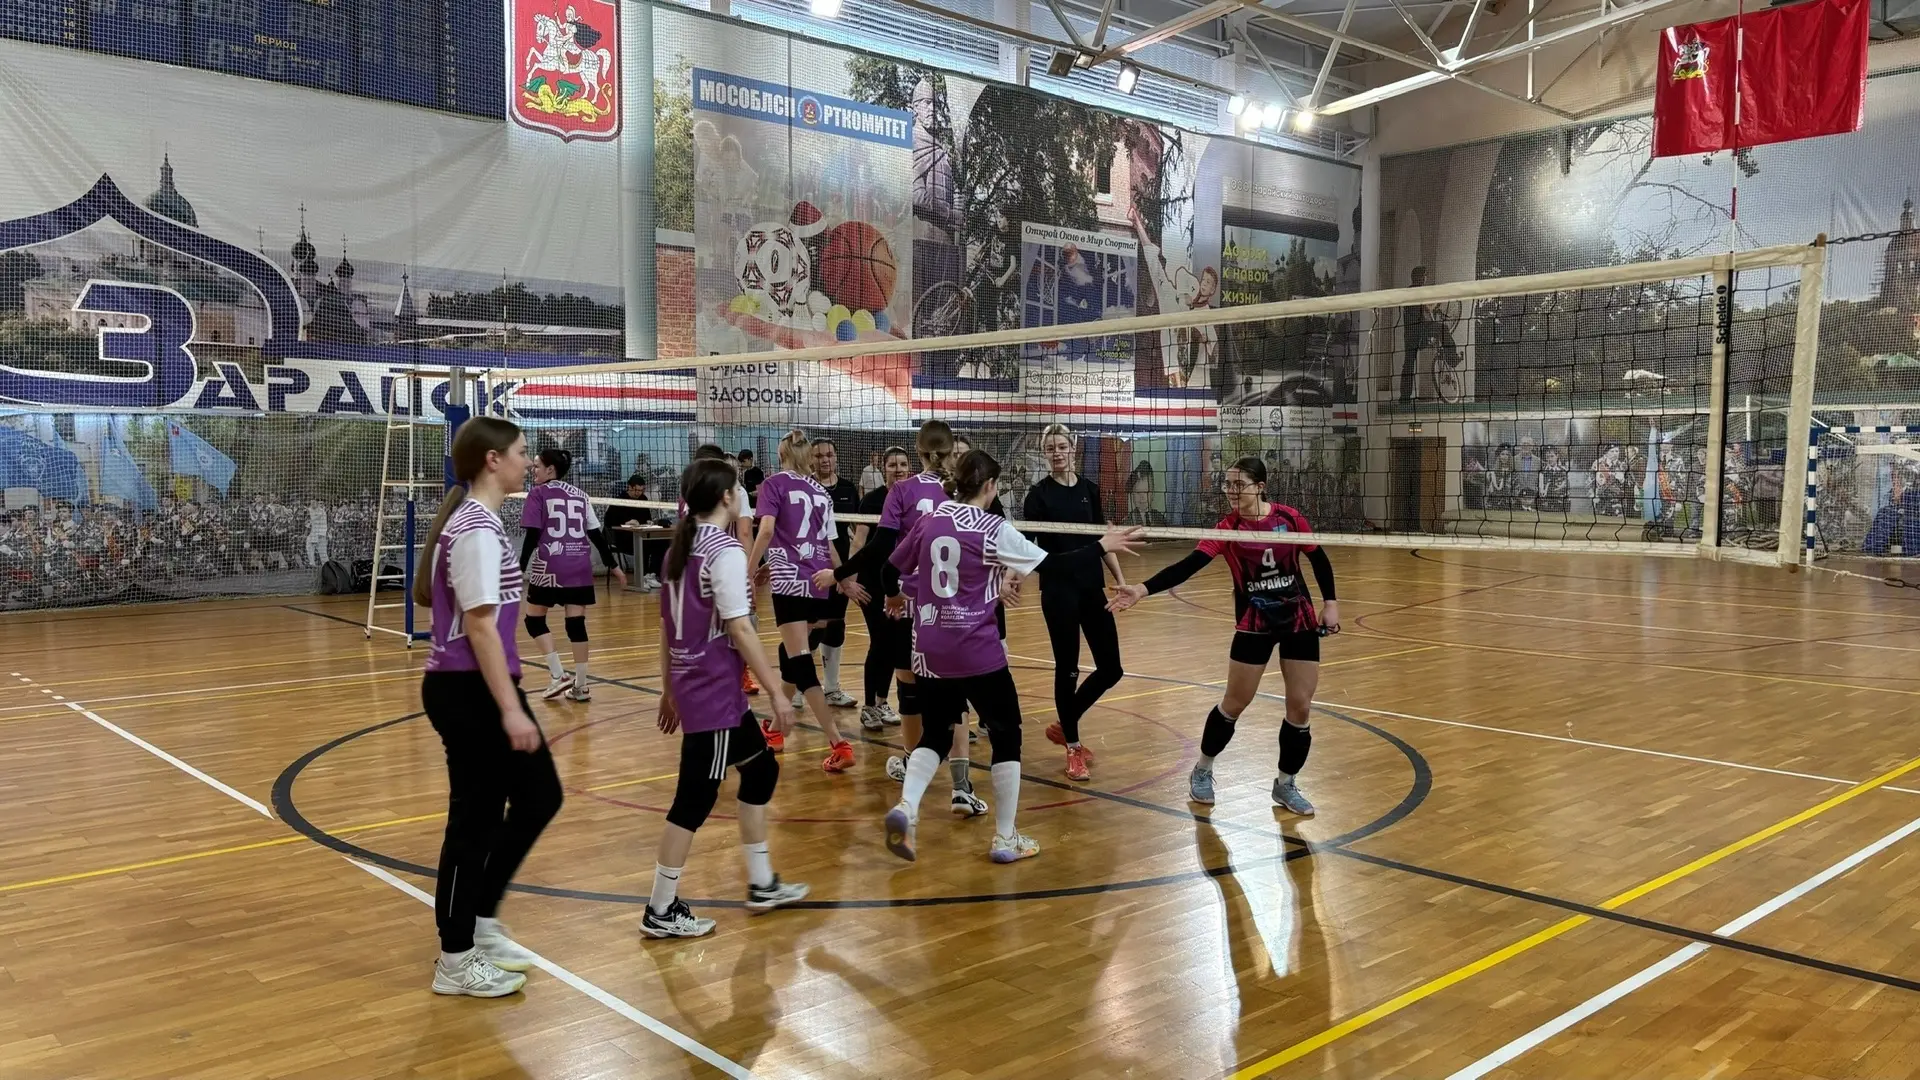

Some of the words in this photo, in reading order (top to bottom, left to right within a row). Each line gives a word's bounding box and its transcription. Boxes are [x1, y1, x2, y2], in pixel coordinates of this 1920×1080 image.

[253, 34, 297, 51] ПЕРИОД
[1025, 225, 1058, 240] Открой
[1060, 230, 1080, 243] Окно
[1087, 235, 1103, 247] Мир
[1104, 238, 1137, 250] Спорта!
[1716, 296, 1727, 345] Schelde
[709, 385, 803, 406] здоровы!
[546, 498, 586, 539] 55
[788, 490, 830, 541] 77
[930, 535, 961, 599] 8
[1261, 547, 1276, 569] 4
